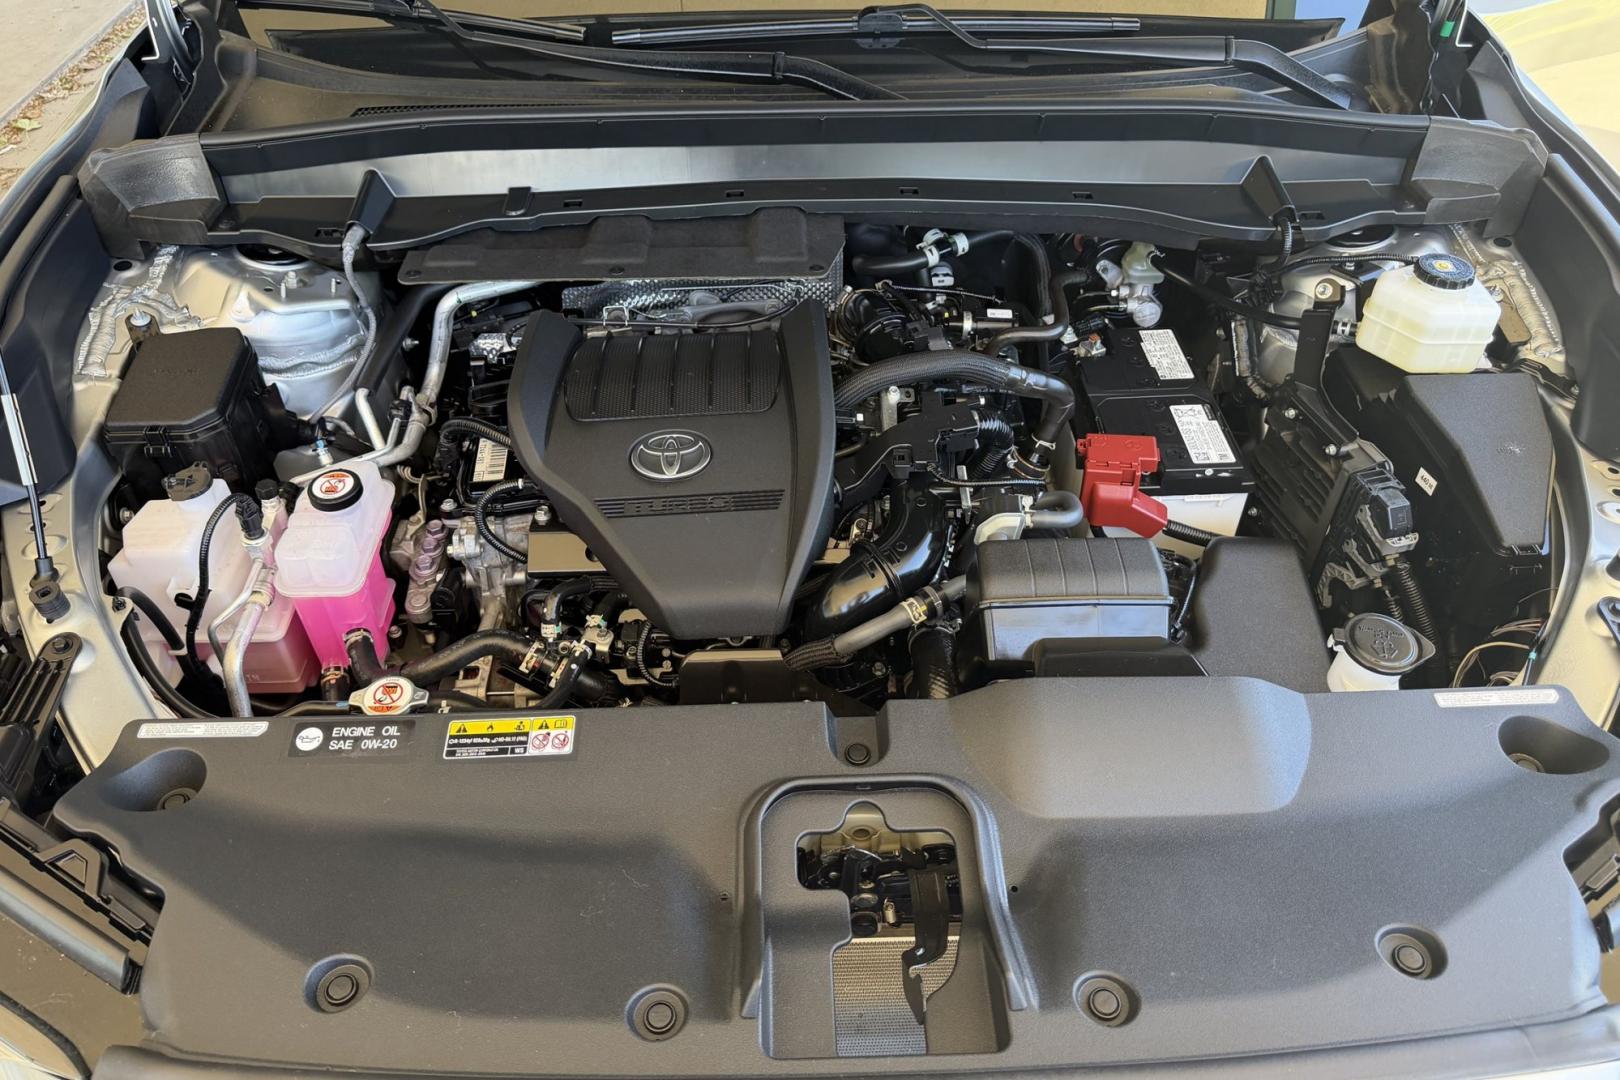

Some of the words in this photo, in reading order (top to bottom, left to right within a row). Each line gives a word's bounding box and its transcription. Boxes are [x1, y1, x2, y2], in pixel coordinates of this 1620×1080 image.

[332, 726, 375, 737] ENGINE
[382, 726, 400, 736] OIL
[329, 740, 353, 750] SAE
[361, 739, 398, 749] 0W-20
